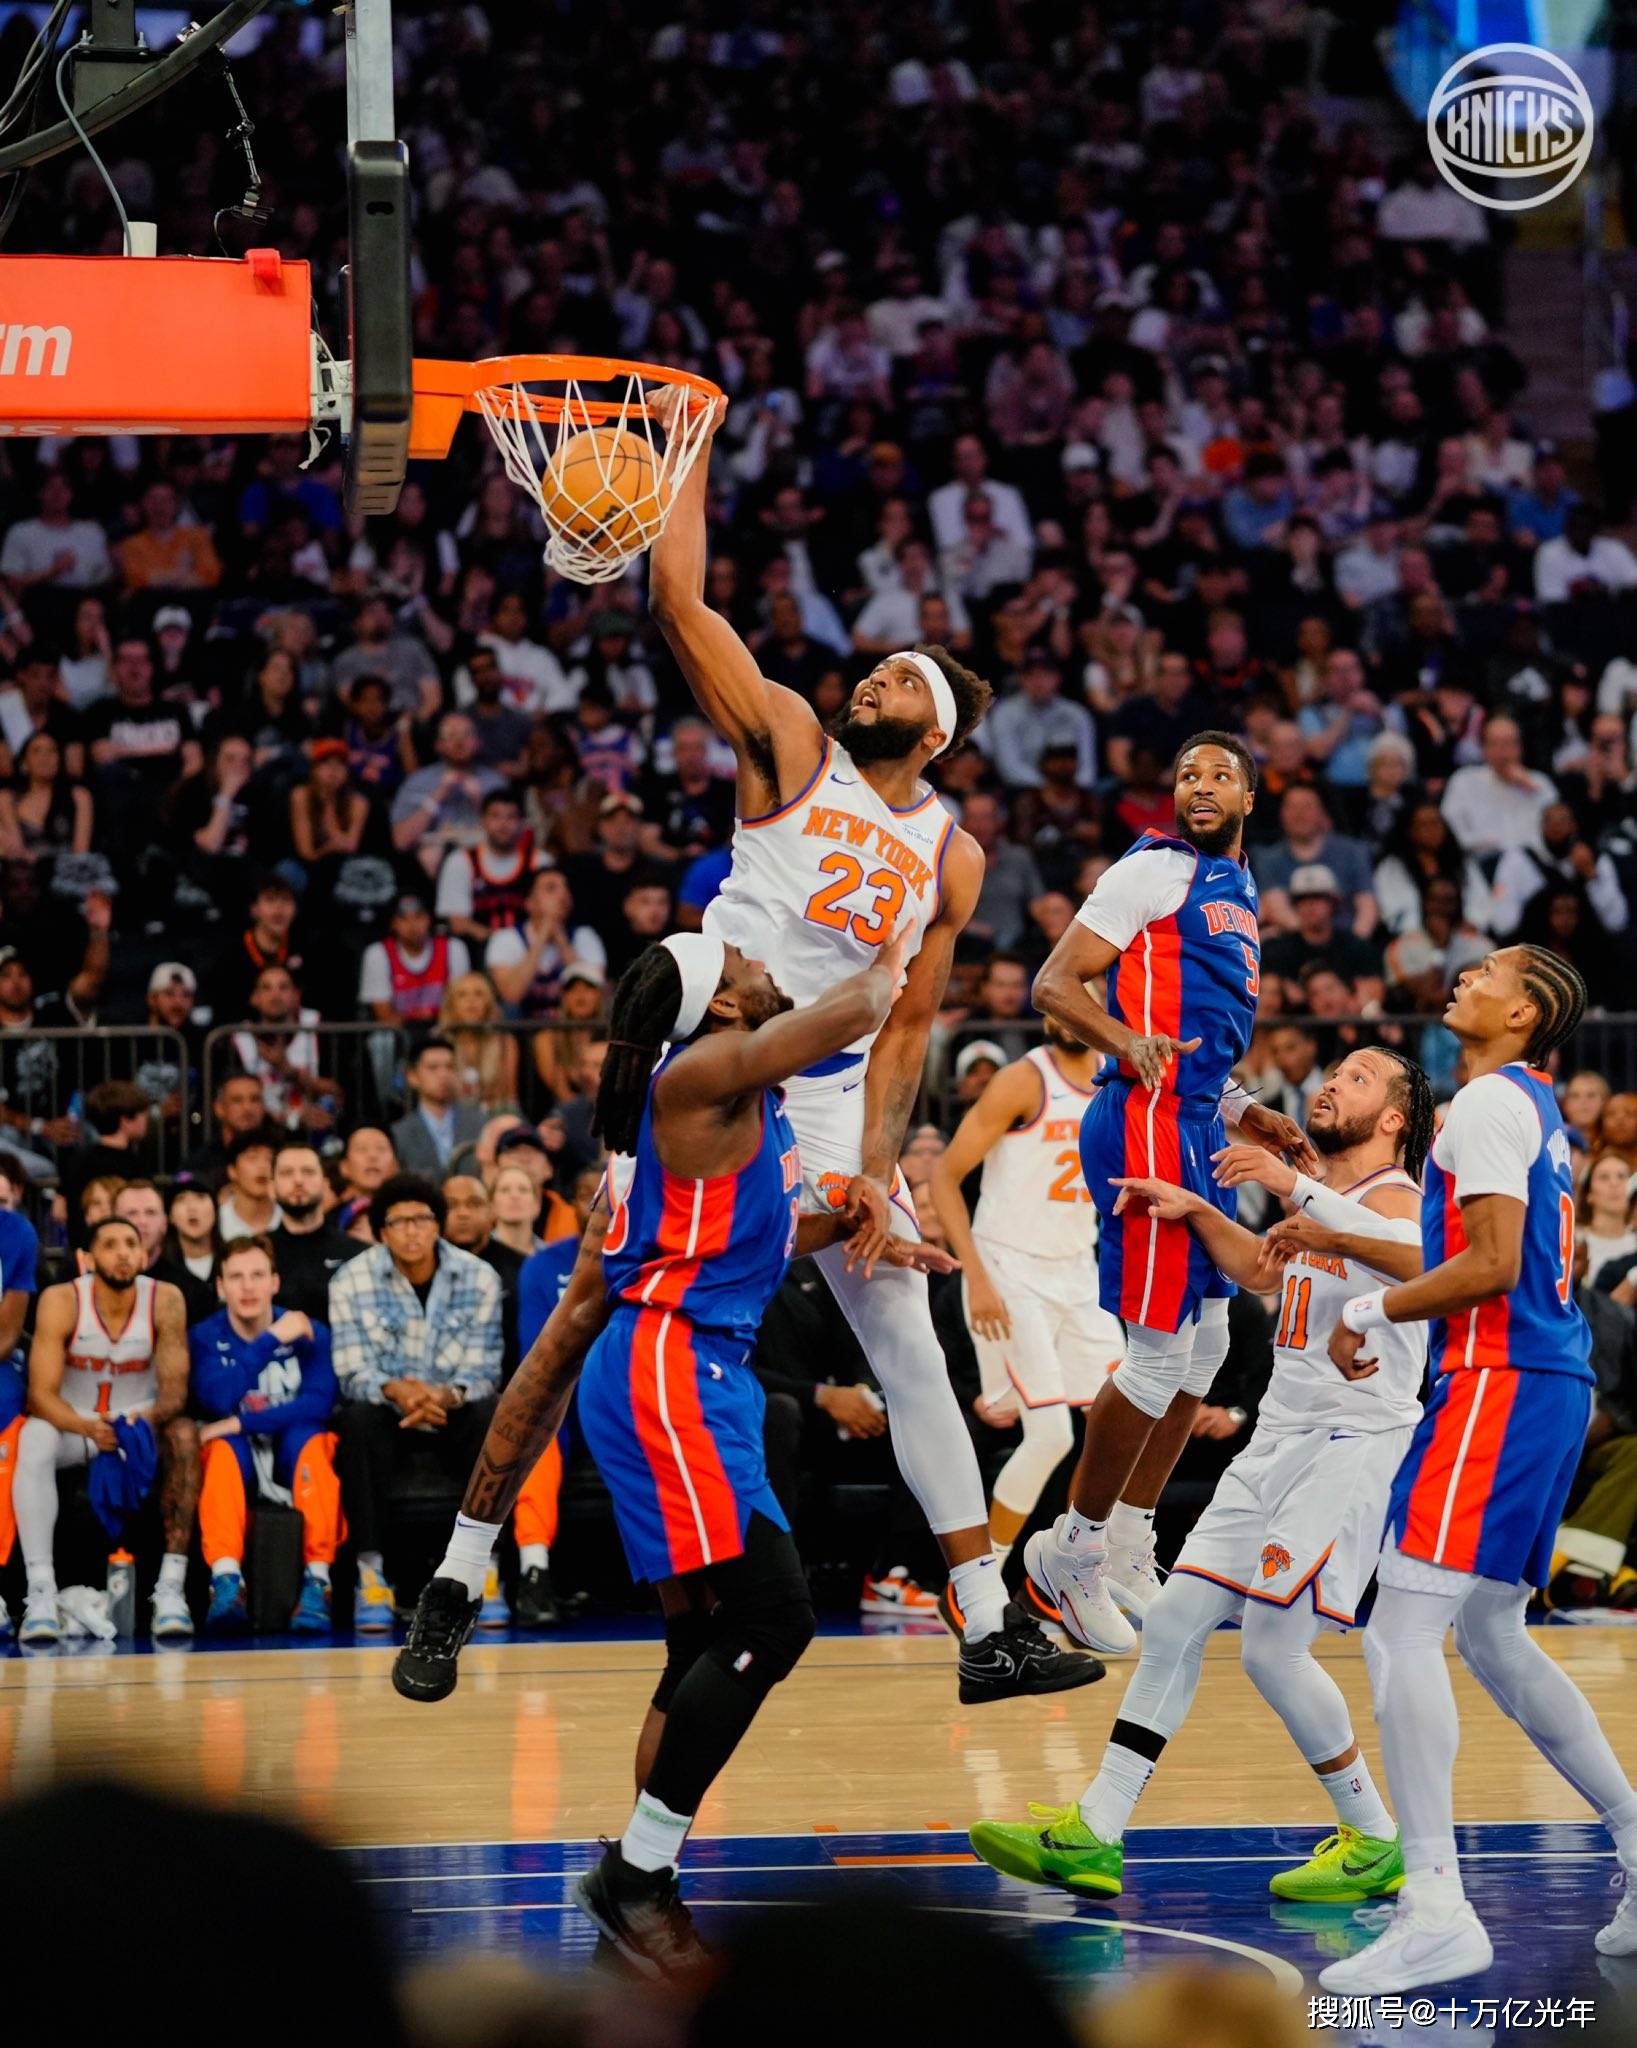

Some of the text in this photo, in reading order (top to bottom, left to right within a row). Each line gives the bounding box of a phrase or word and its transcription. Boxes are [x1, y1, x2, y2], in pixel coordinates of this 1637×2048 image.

[802, 806, 875, 848] NEW
[874, 826, 934, 901] YORK
[804, 851, 907, 947] 23
[1240, 941, 1260, 997] 5
[1048, 1150, 1093, 1203] 2
[1276, 1275, 1312, 1350] 11
[94, 1381, 112, 1413] 1
